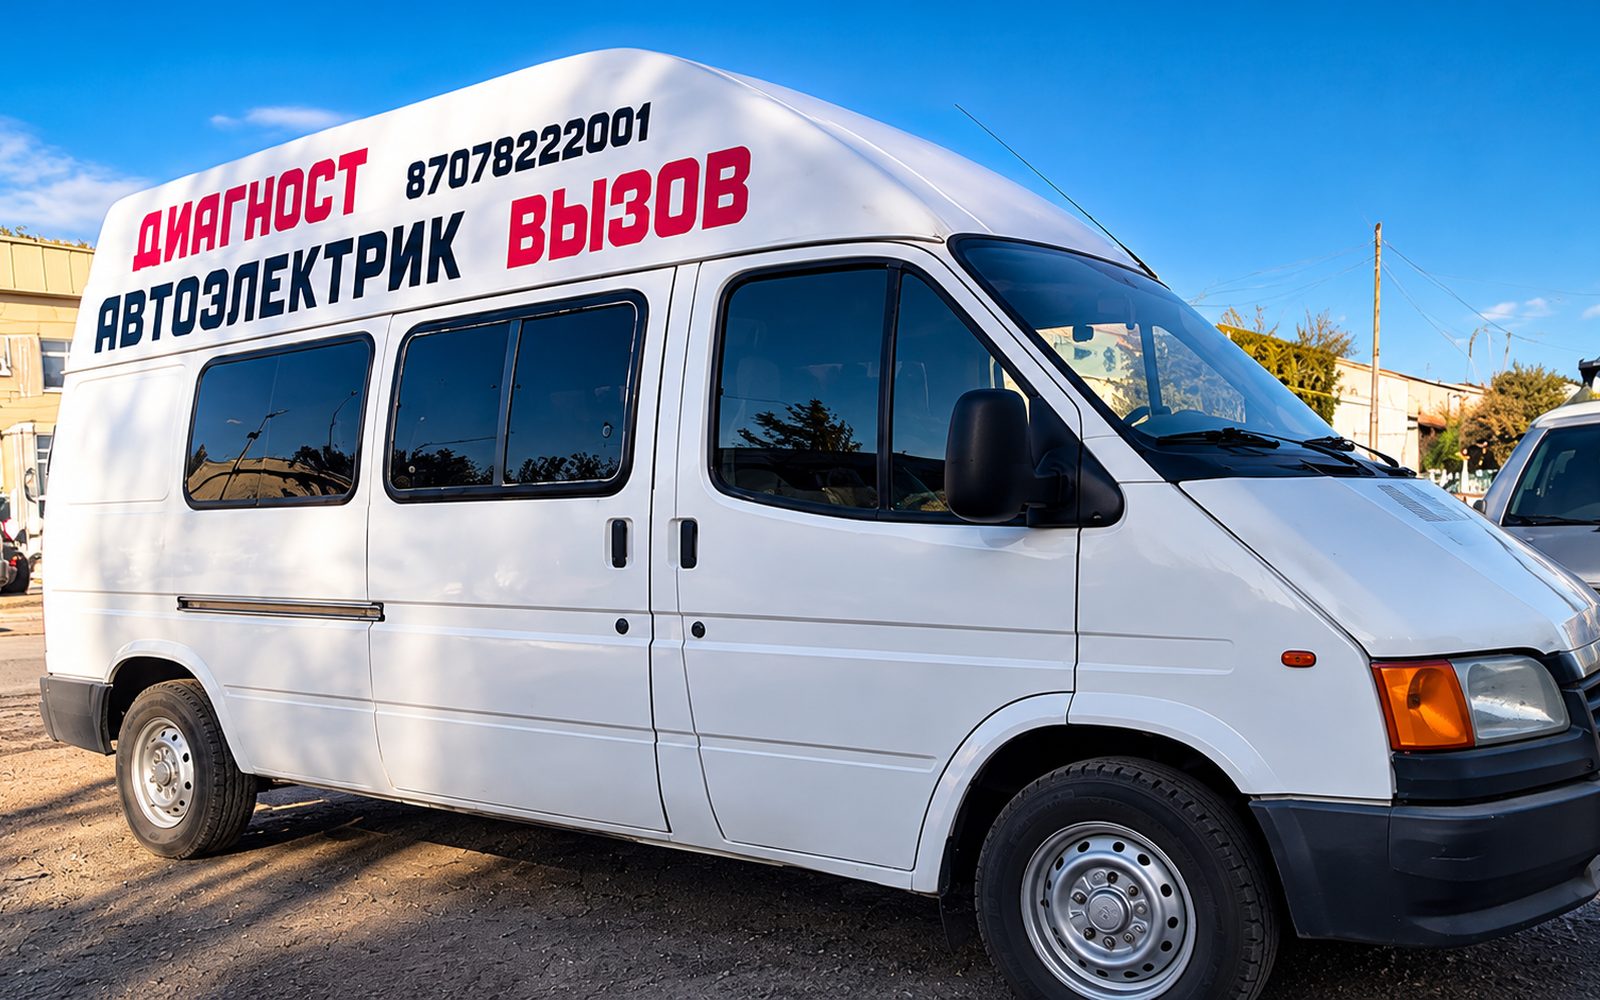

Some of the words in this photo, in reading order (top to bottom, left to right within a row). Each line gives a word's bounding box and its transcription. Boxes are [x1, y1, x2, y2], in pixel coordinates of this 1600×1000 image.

[132, 147, 369, 272] ДИАГНОСТ
[405, 101, 651, 200] 87078222001
[506, 146, 751, 270] ВЫЗОВ
[94, 210, 465, 354] АВТОЭЛЕКТРИК
